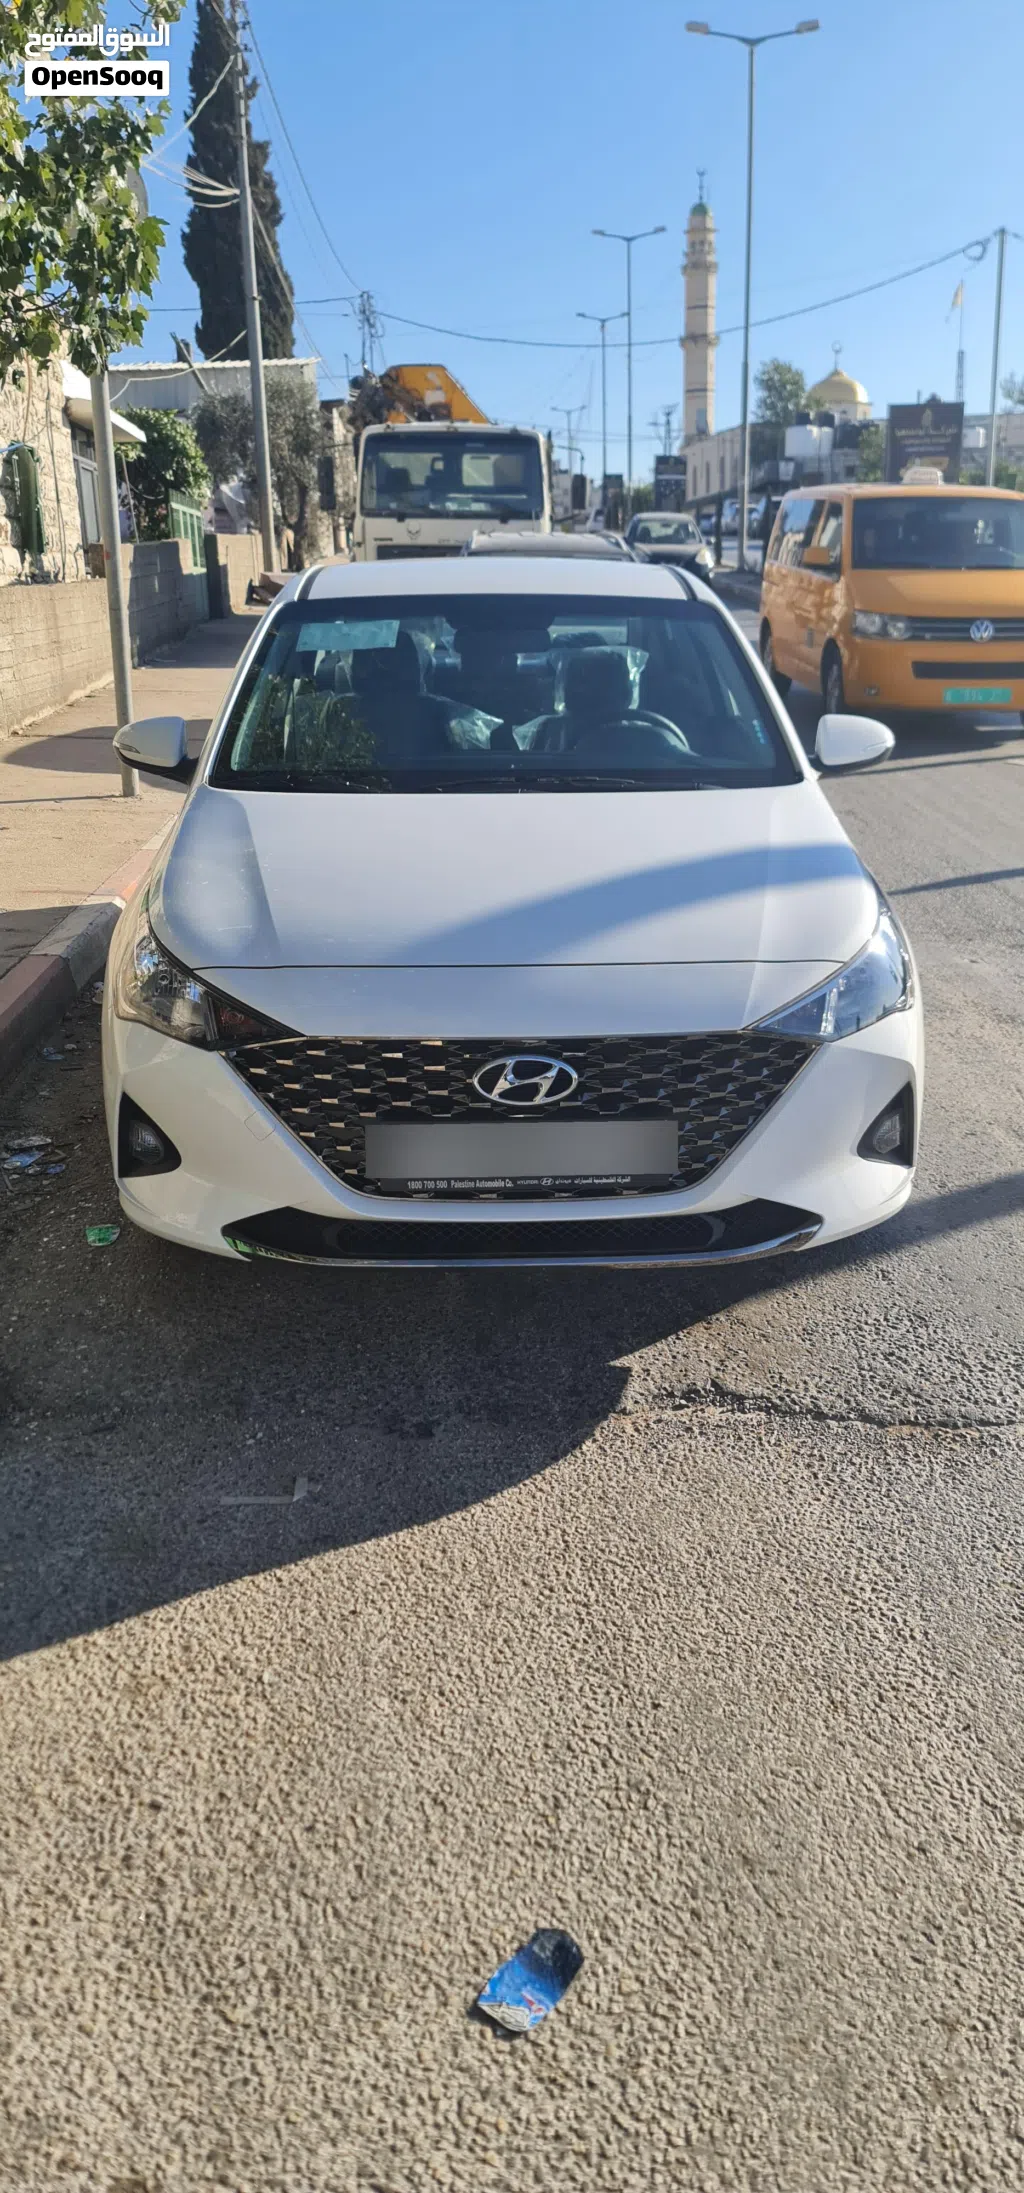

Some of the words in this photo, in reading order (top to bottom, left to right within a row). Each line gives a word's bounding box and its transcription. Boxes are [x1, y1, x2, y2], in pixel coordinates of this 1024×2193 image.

[407, 1180, 422, 1189] 1800
[424, 1180, 435, 1189] 700
[436, 1180, 448, 1188] 500
[450, 1179, 475, 1188] Palestine
[475, 1178, 505, 1188] Automobile
[505, 1178, 514, 1187] Co.
